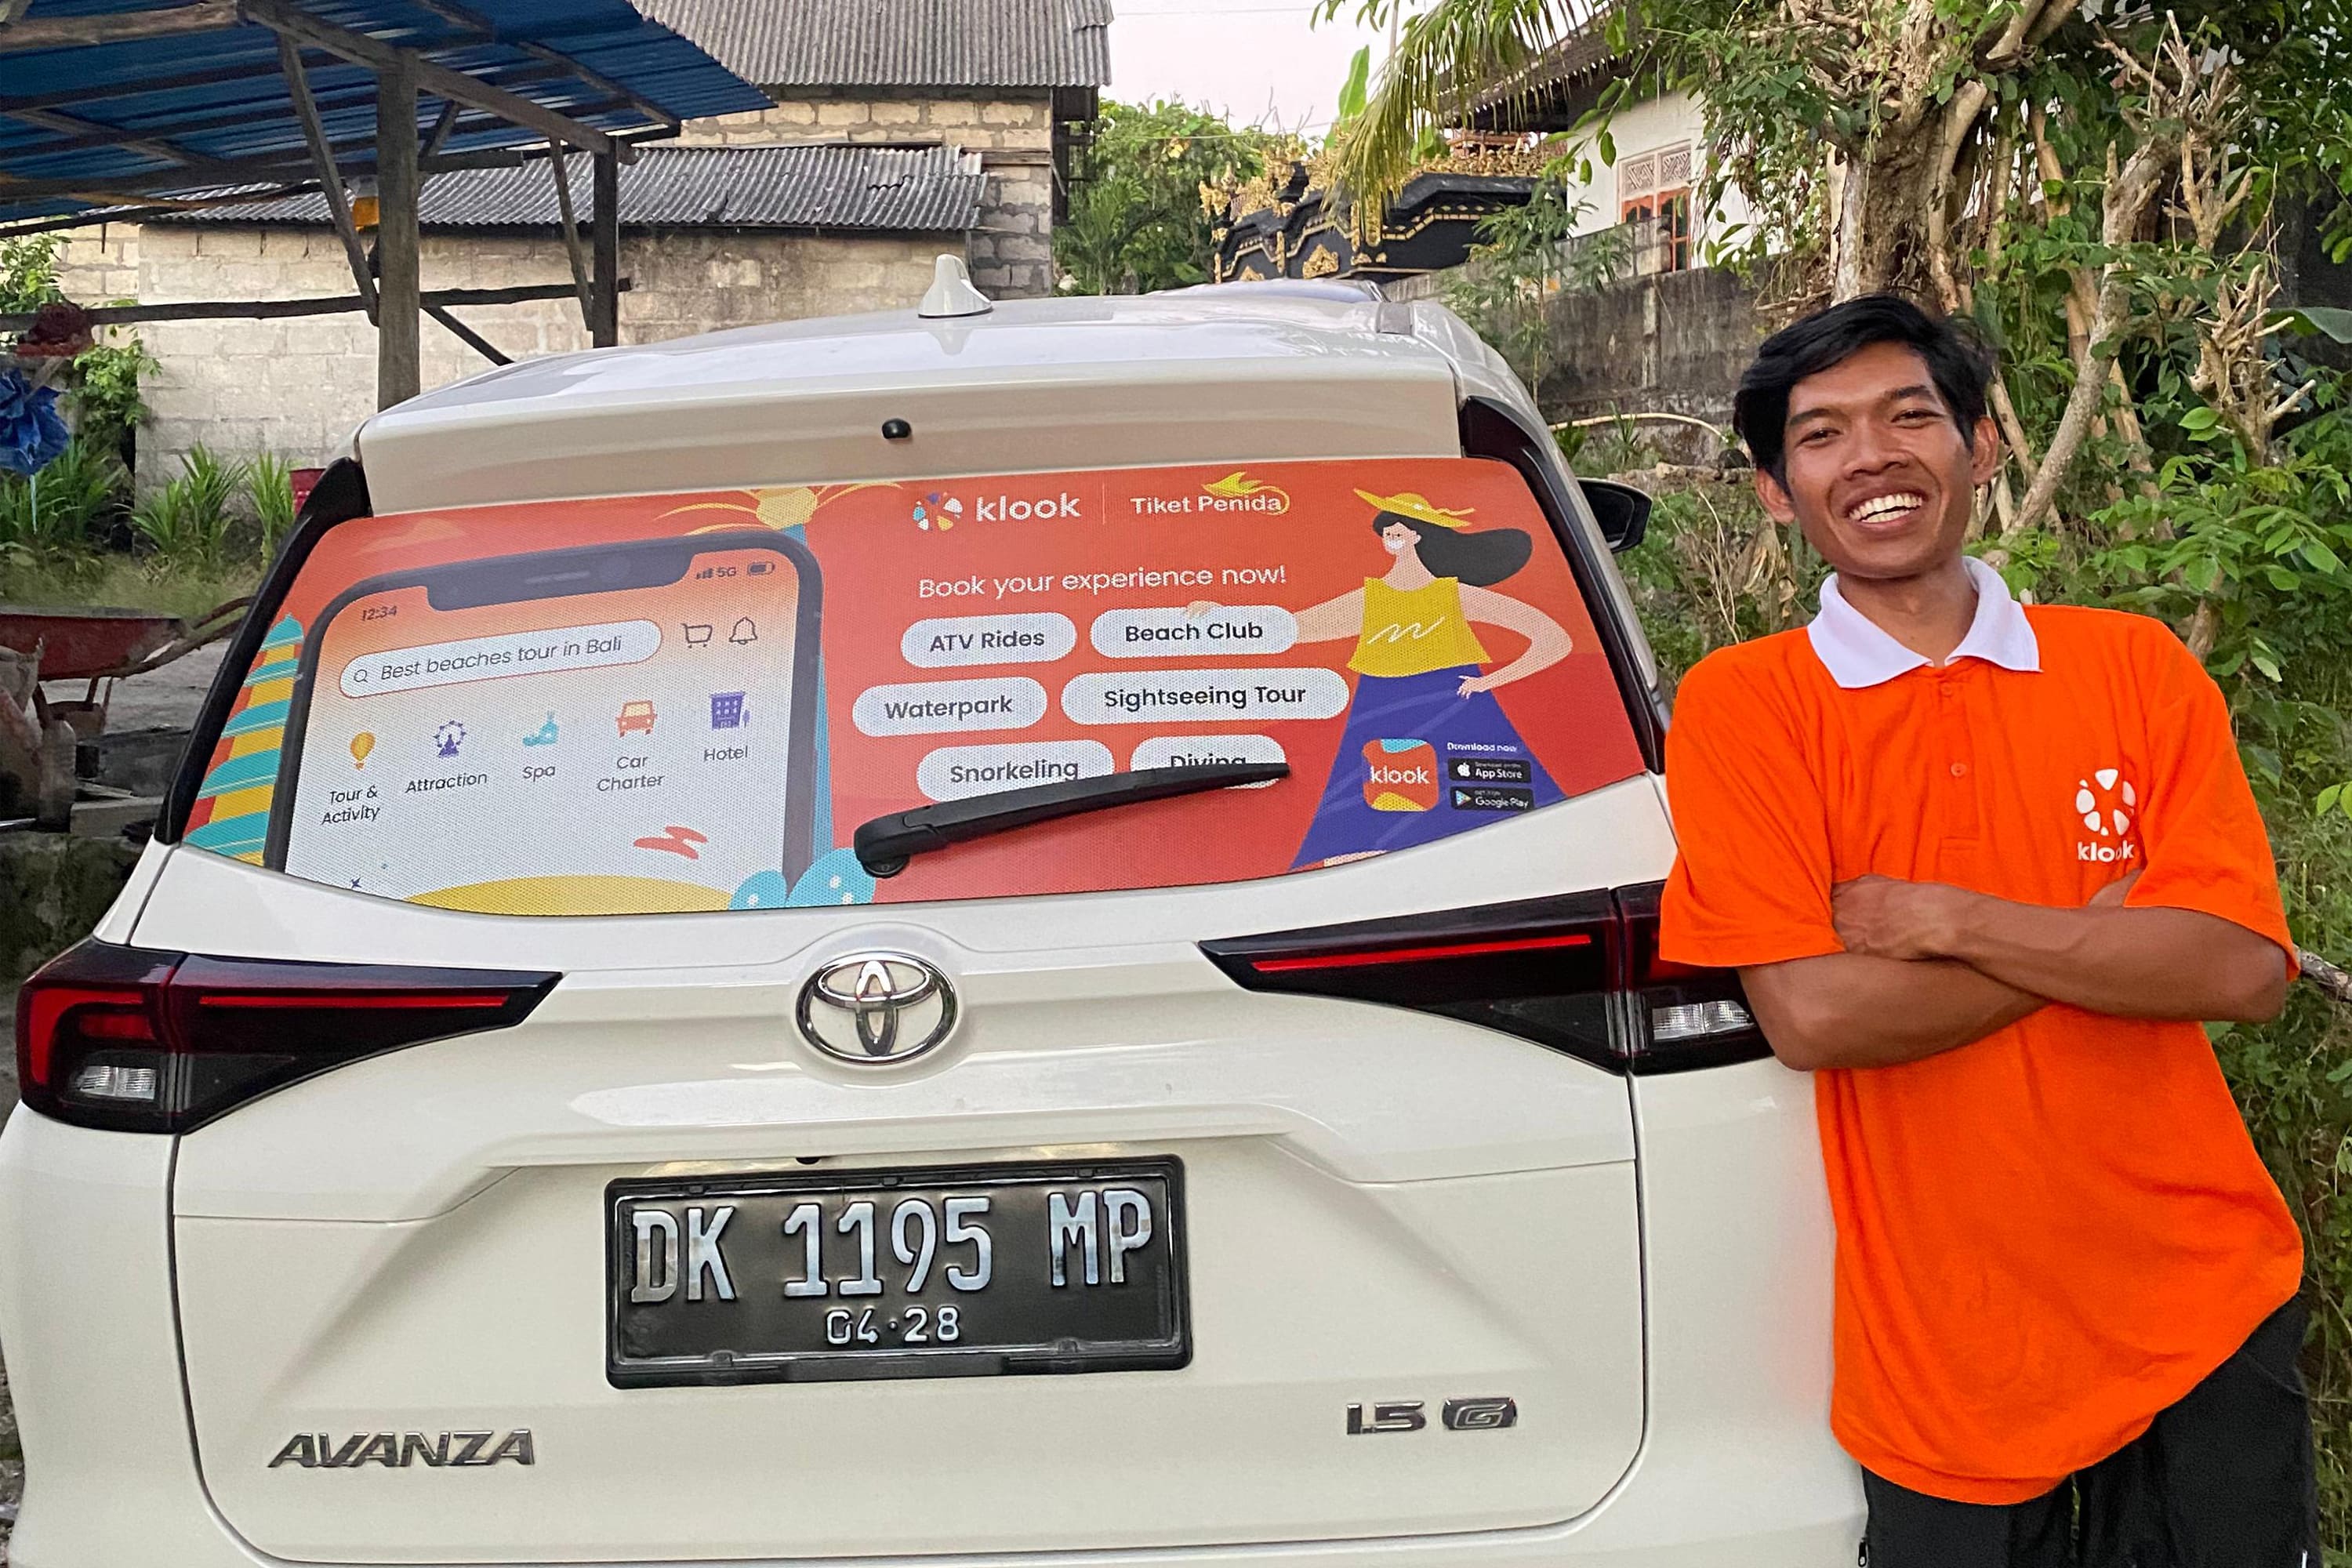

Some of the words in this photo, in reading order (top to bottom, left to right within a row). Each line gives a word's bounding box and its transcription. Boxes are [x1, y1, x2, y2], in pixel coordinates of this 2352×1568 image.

[976, 493, 1082, 522] klook
[1130, 496, 1192, 514] Tiket
[1198, 495, 1282, 512] Penida
[718, 567, 736, 577] 5G
[920, 575, 985, 598] Book
[993, 573, 1054, 599] your
[1062, 566, 1213, 595] experience
[1221, 565, 1286, 585] now!
[361, 606, 397, 621] 12:34
[930, 633, 974, 652] ATV
[982, 630, 1045, 648] Rides
[1125, 623, 1200, 642] Beach
[1207, 622, 1263, 639] Club
[381, 662, 420, 680] Best
[426, 652, 510, 673] beaches
[518, 646, 558, 662] tour
[563, 641, 579, 657] in
[587, 636, 622, 654] Bali
[884, 695, 1013, 721] Waterpark
[1104, 686, 1247, 713] Sightseeing
[1254, 686, 1306, 704] Tour
[617, 755, 648, 769] Car
[704, 745, 748, 761] Hotel
[522, 765, 556, 782] Spa
[950, 759, 1079, 783] Snorkeling
[1370, 765, 1430, 784] klook
[1475, 768, 1496, 779] App
[1497, 768, 1523, 779] Store
[405, 772, 488, 793] Attraction
[597, 774, 665, 792] Charter
[329, 788, 363, 804] Tour
[366, 785, 378, 798] &
[1475, 797, 1508, 808] Google
[1509, 797, 1529, 809] Play
[321, 804, 380, 825] Activity
[630, 1206, 736, 1304] DK
[783, 1196, 993, 1298] 1195
[1048, 1189, 1153, 1287] MP
[267, 1428, 535, 1468] AVANZA
